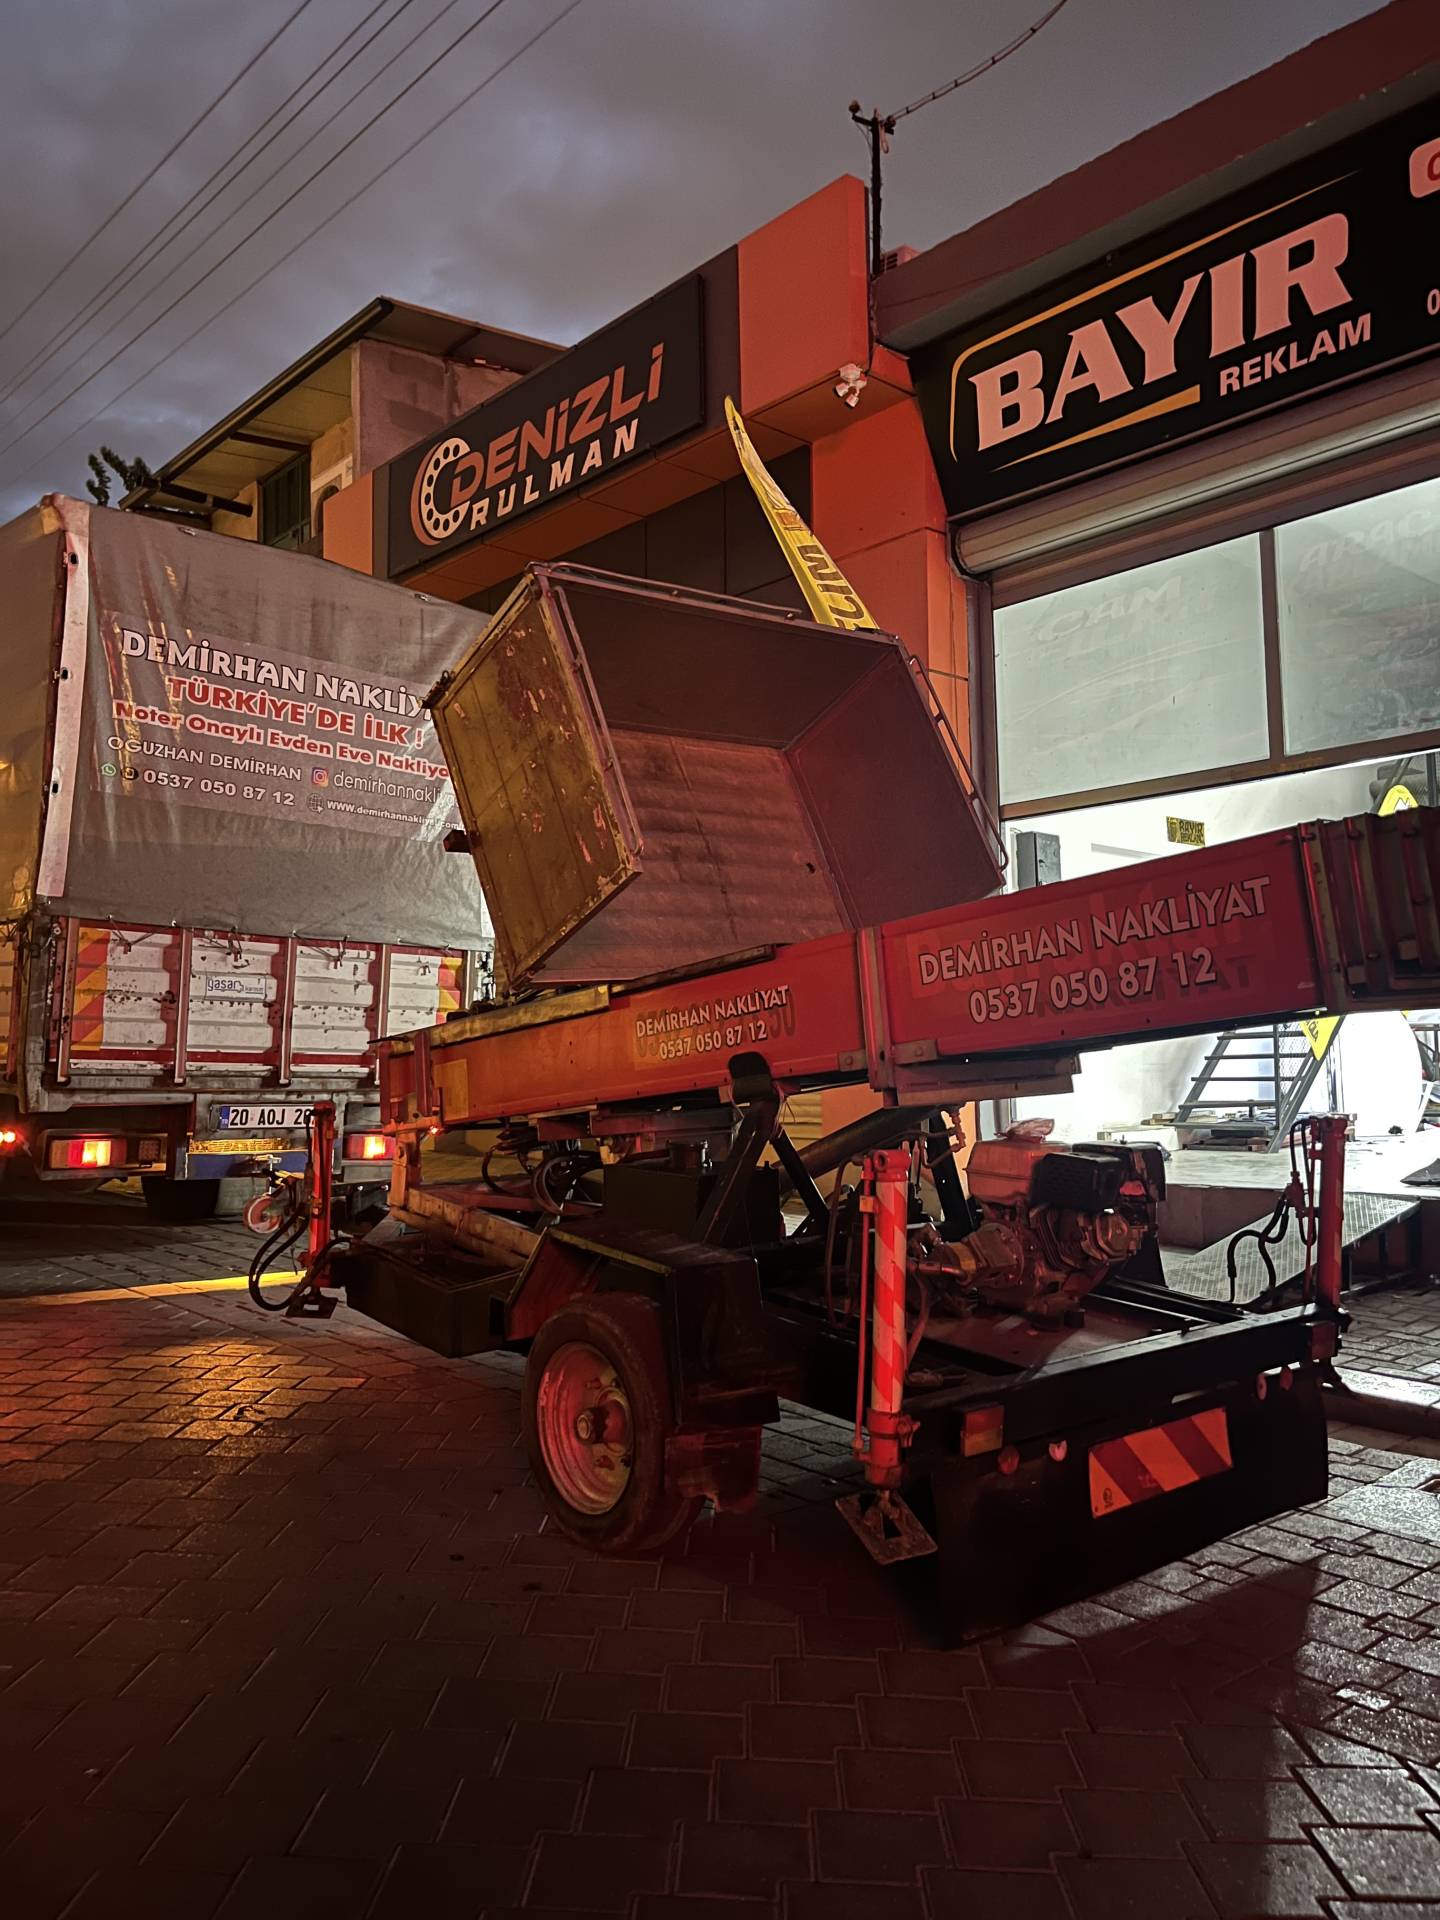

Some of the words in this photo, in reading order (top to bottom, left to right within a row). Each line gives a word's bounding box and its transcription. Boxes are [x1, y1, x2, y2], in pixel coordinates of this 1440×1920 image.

[967, 213, 1354, 452] BAYIR
[1218, 312, 1372, 397] REKLAM
[450, 341, 664, 510] DENİZLİ
[469, 417, 640, 532] RULMAN
[121, 628, 307, 695] DEMİRHAN
[315, 678, 434, 722] NAKLİY
[167, 676, 356, 736] TÜRKİYE'DE
[364, 713, 411, 746] İLK
[112, 699, 185, 730] Noter
[187, 714, 264, 747] Onaylı
[269, 729, 334, 759] Evden
[338, 744, 374, 765] Eve
[210, 753, 302, 781] DEMİRHAN
[143, 769, 194, 790] 0537
[200, 778, 237, 797] 050
[242, 785, 267, 802] 87
[272, 791, 296, 807] 12
[918, 919, 1082, 985] DEMİRHAN
[1092, 875, 1271, 949] NAKLİYAT
[635, 1005, 711, 1038] DEMİRHAN
[714, 984, 789, 1021] NAKLİYAT
[969, 981, 1039, 1024] 0537
[1050, 966, 1109, 1010] 050
[1118, 956, 1158, 998] 87
[1172, 946, 1217, 988] 12
[659, 1036, 691, 1060] 0537
[696, 1030, 722, 1053] 050
[726, 1025, 743, 1047] 87
[749, 1019, 768, 1041] 12
[229, 1108, 249, 1127] 20
[257, 1108, 286, 1126] AOJ
